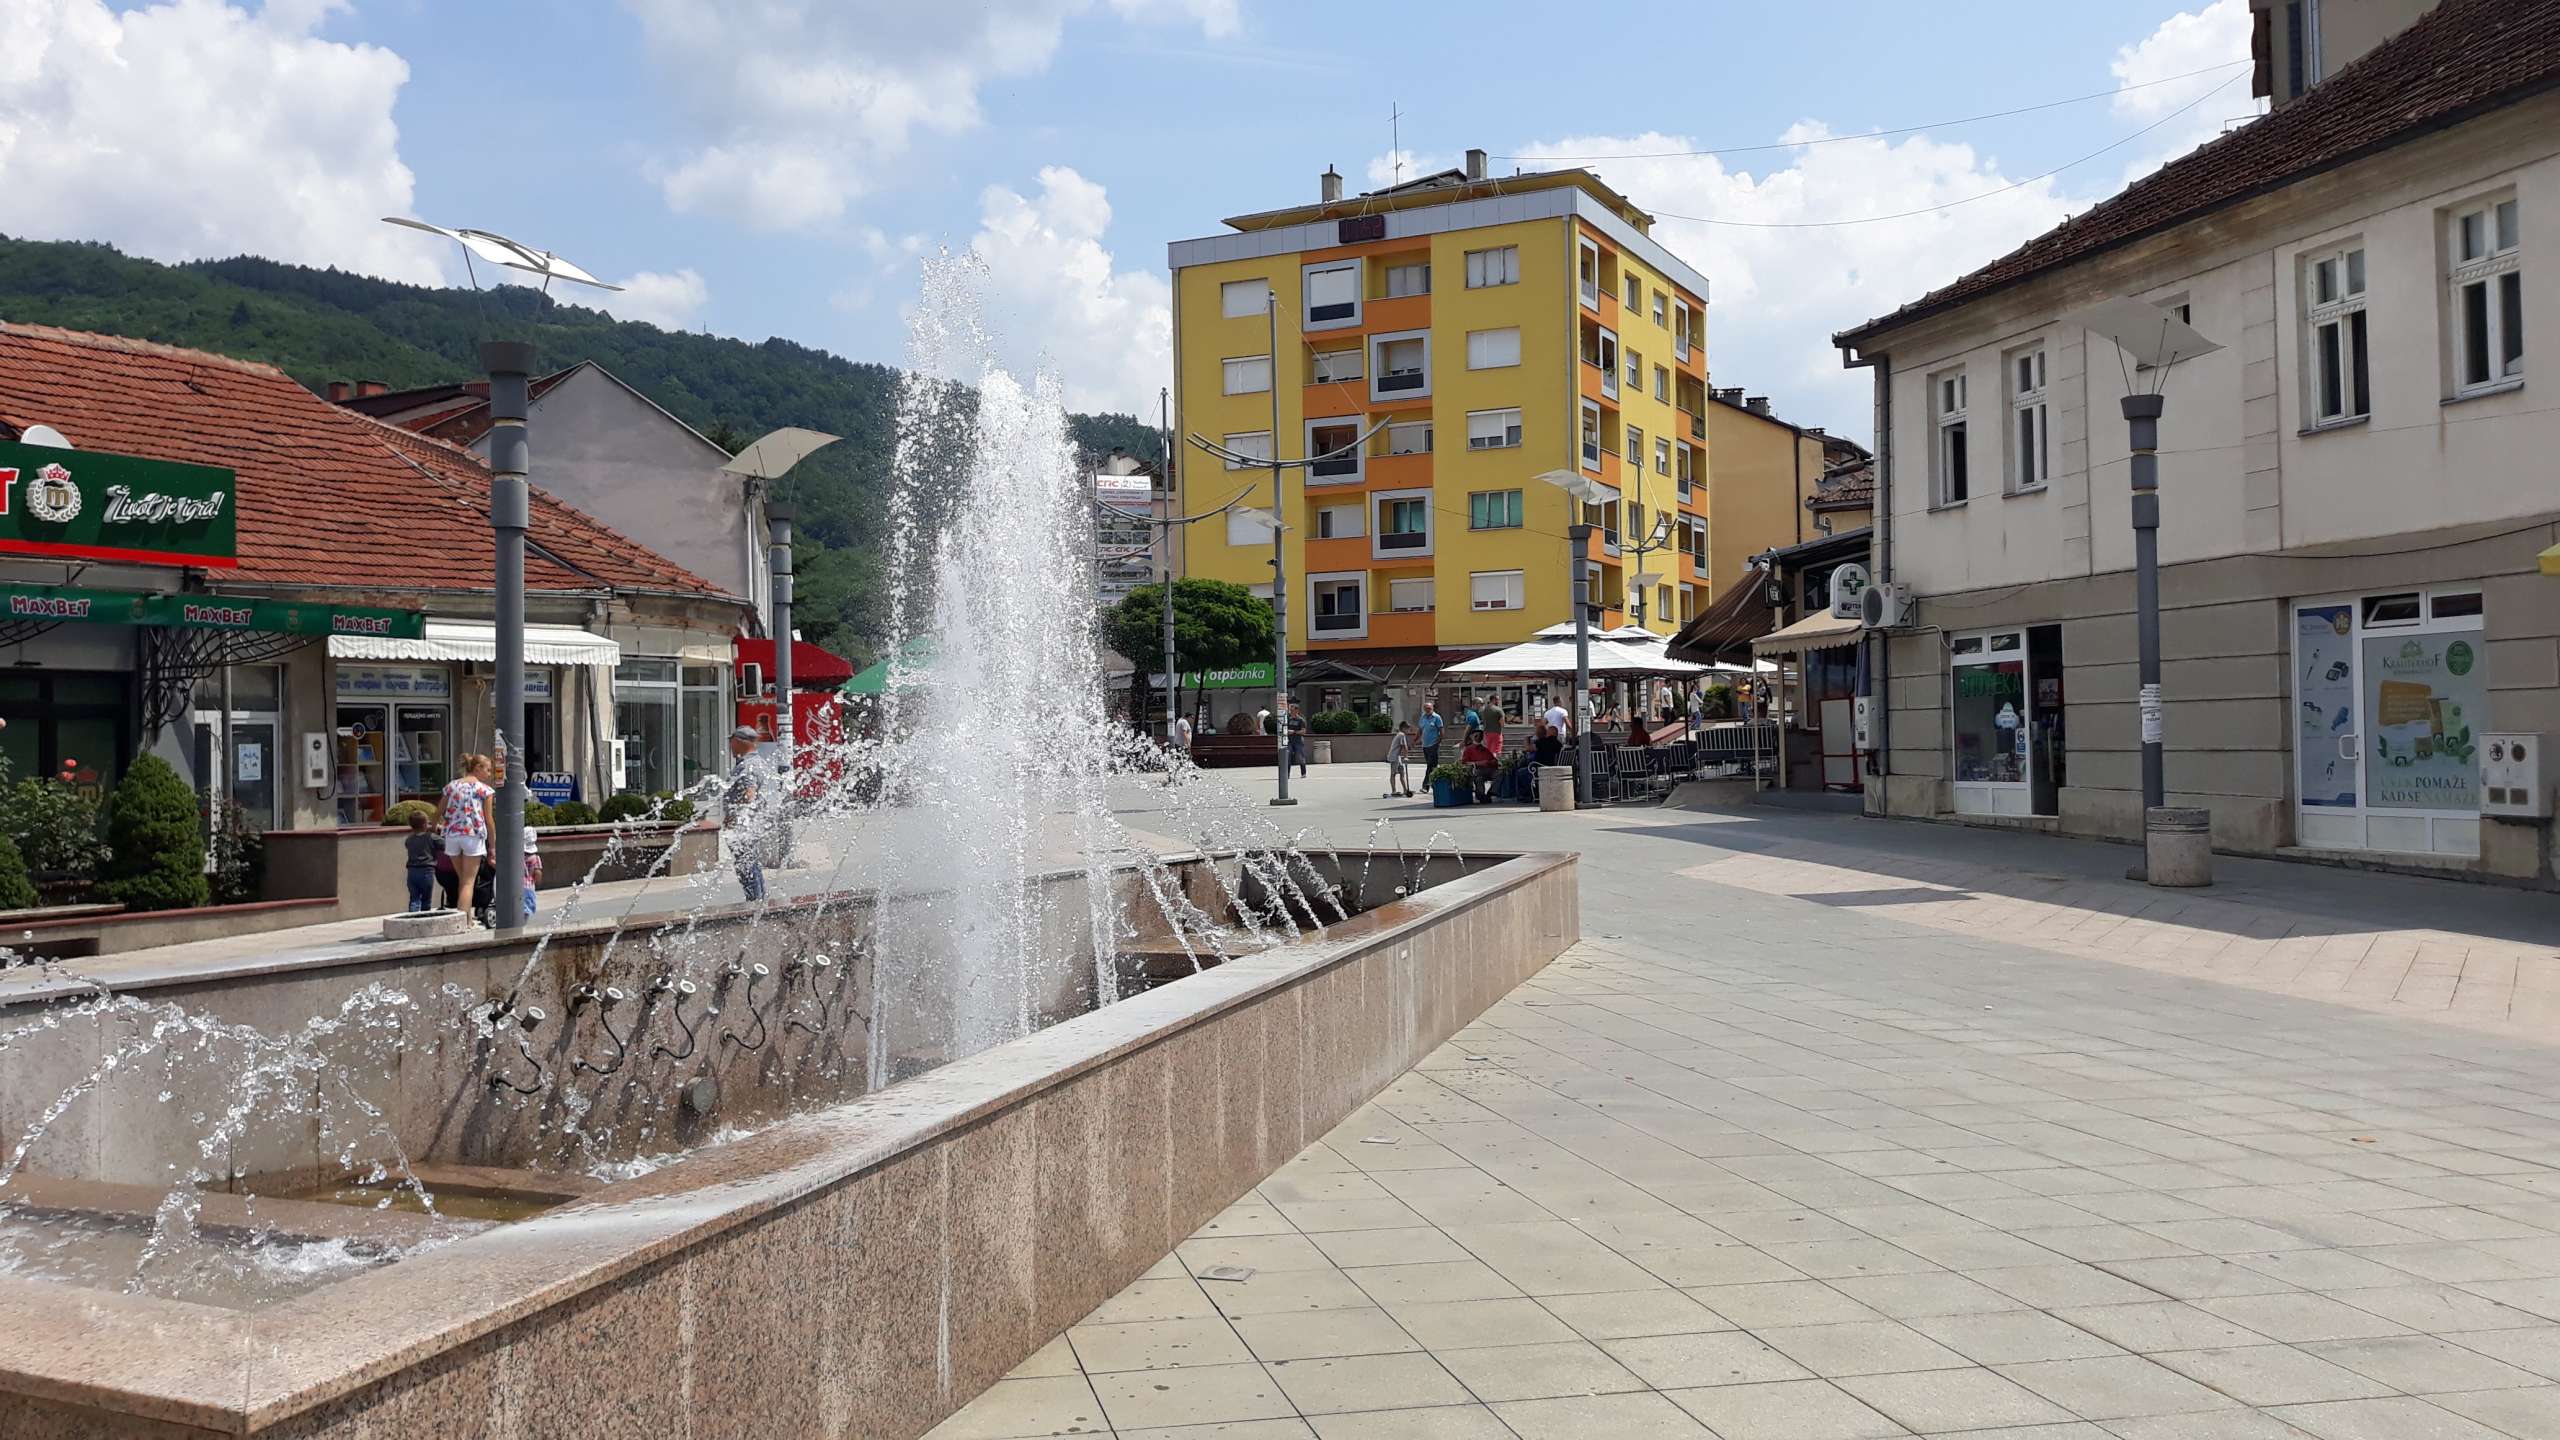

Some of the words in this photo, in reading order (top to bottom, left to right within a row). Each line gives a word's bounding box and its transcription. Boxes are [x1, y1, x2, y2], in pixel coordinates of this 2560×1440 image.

[109, 485, 162, 521] Život
[182, 492, 225, 520] igra!
[10, 595, 91, 617] MAXBET
[184, 604, 253, 626] MAXBET
[332, 614, 392, 633] MAXBET
